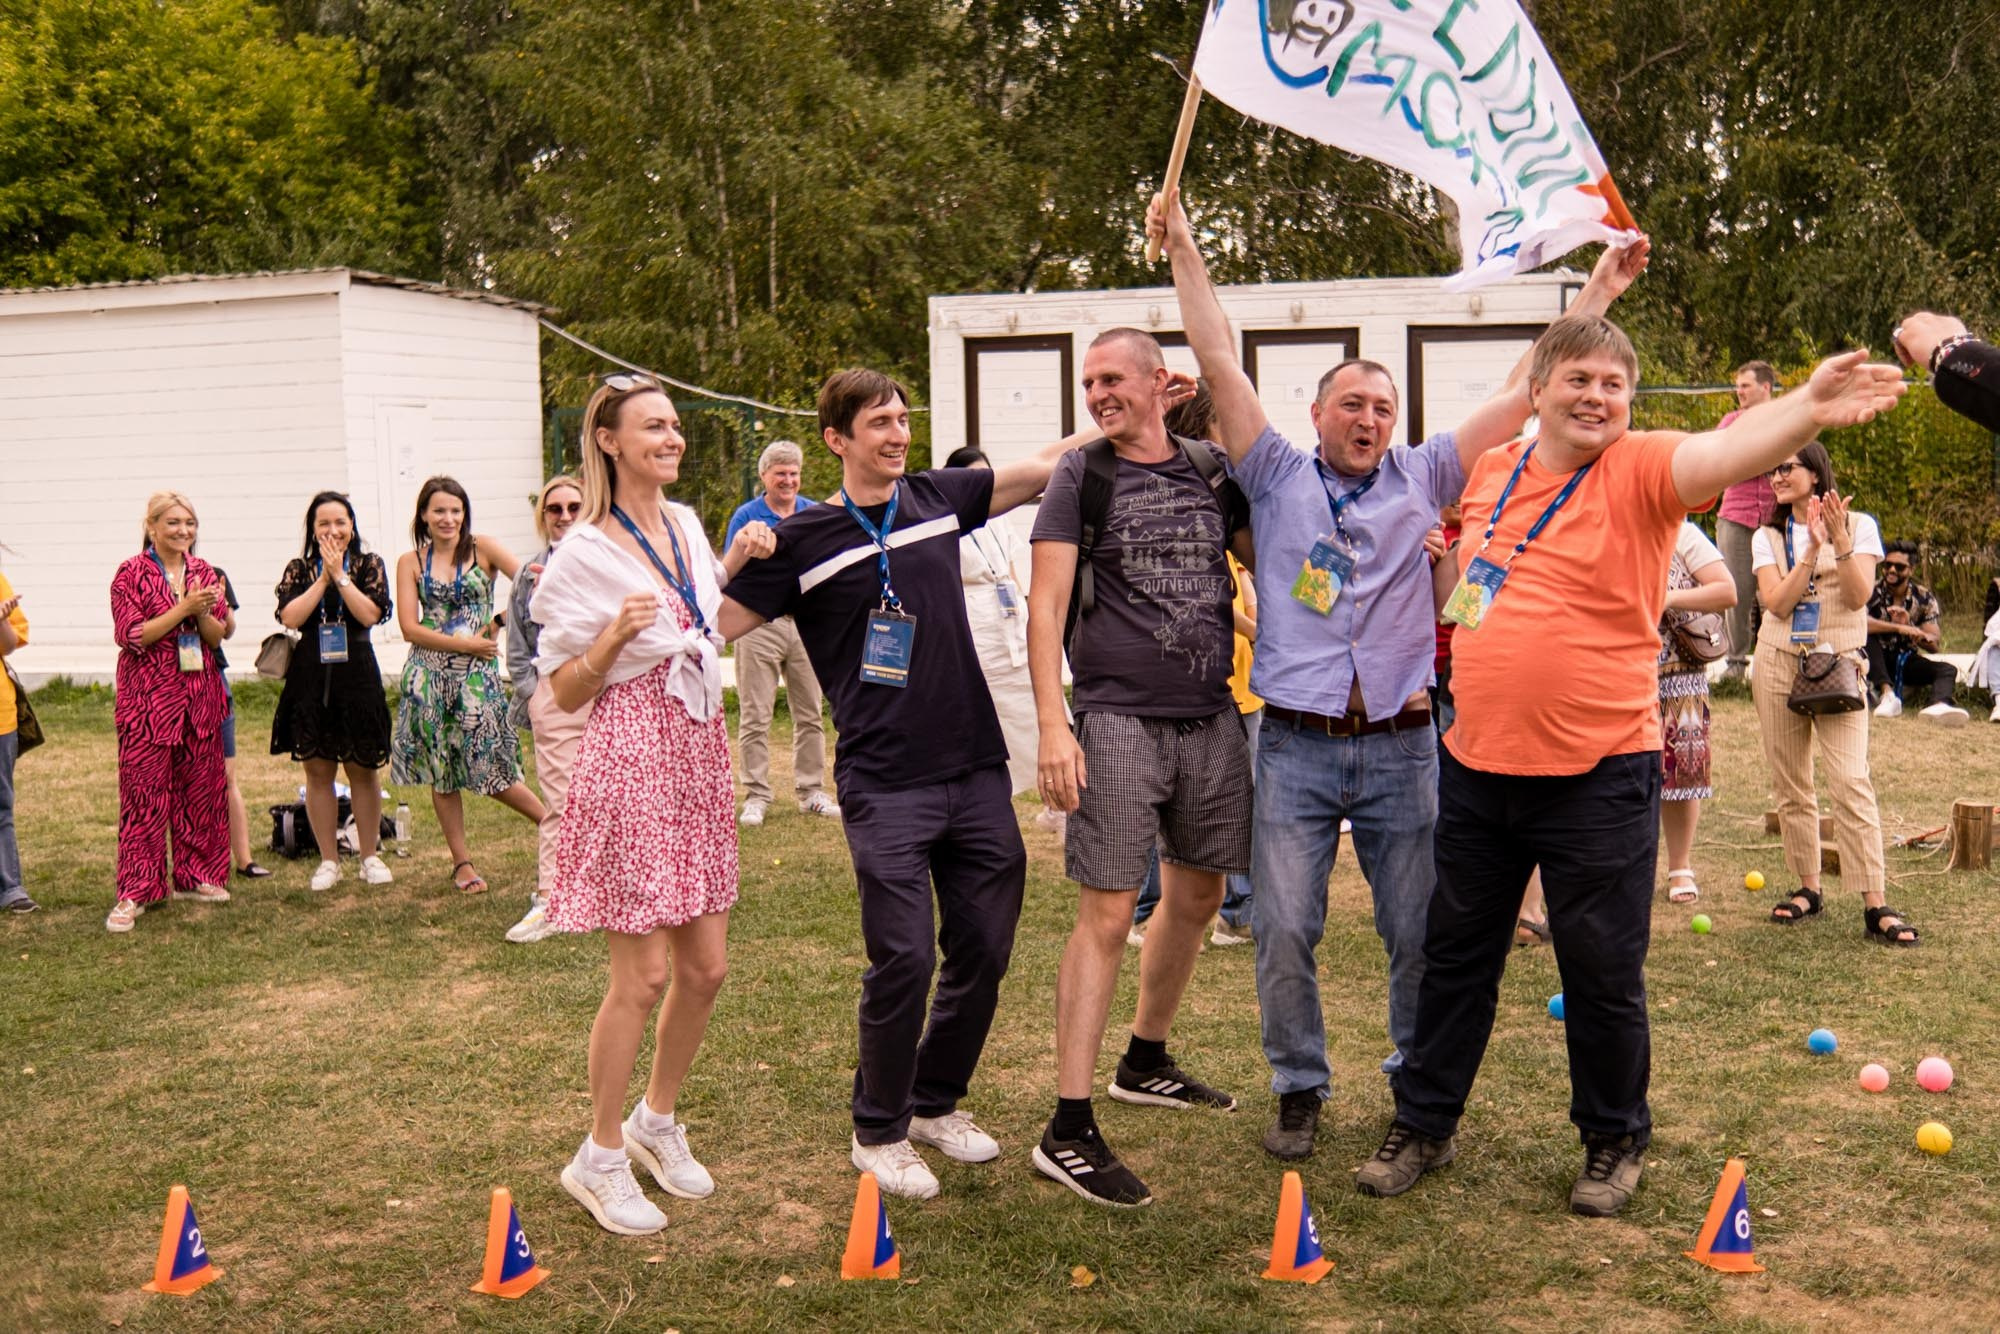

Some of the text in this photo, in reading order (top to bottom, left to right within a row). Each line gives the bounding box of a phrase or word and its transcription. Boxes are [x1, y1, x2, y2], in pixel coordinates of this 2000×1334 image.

[1142, 578, 1218, 594] OUTVENTURE
[1307, 1215, 1319, 1245] 5
[1734, 1208, 1750, 1239] 6
[188, 1227, 206, 1258] 2
[514, 1229, 531, 1258] 3
